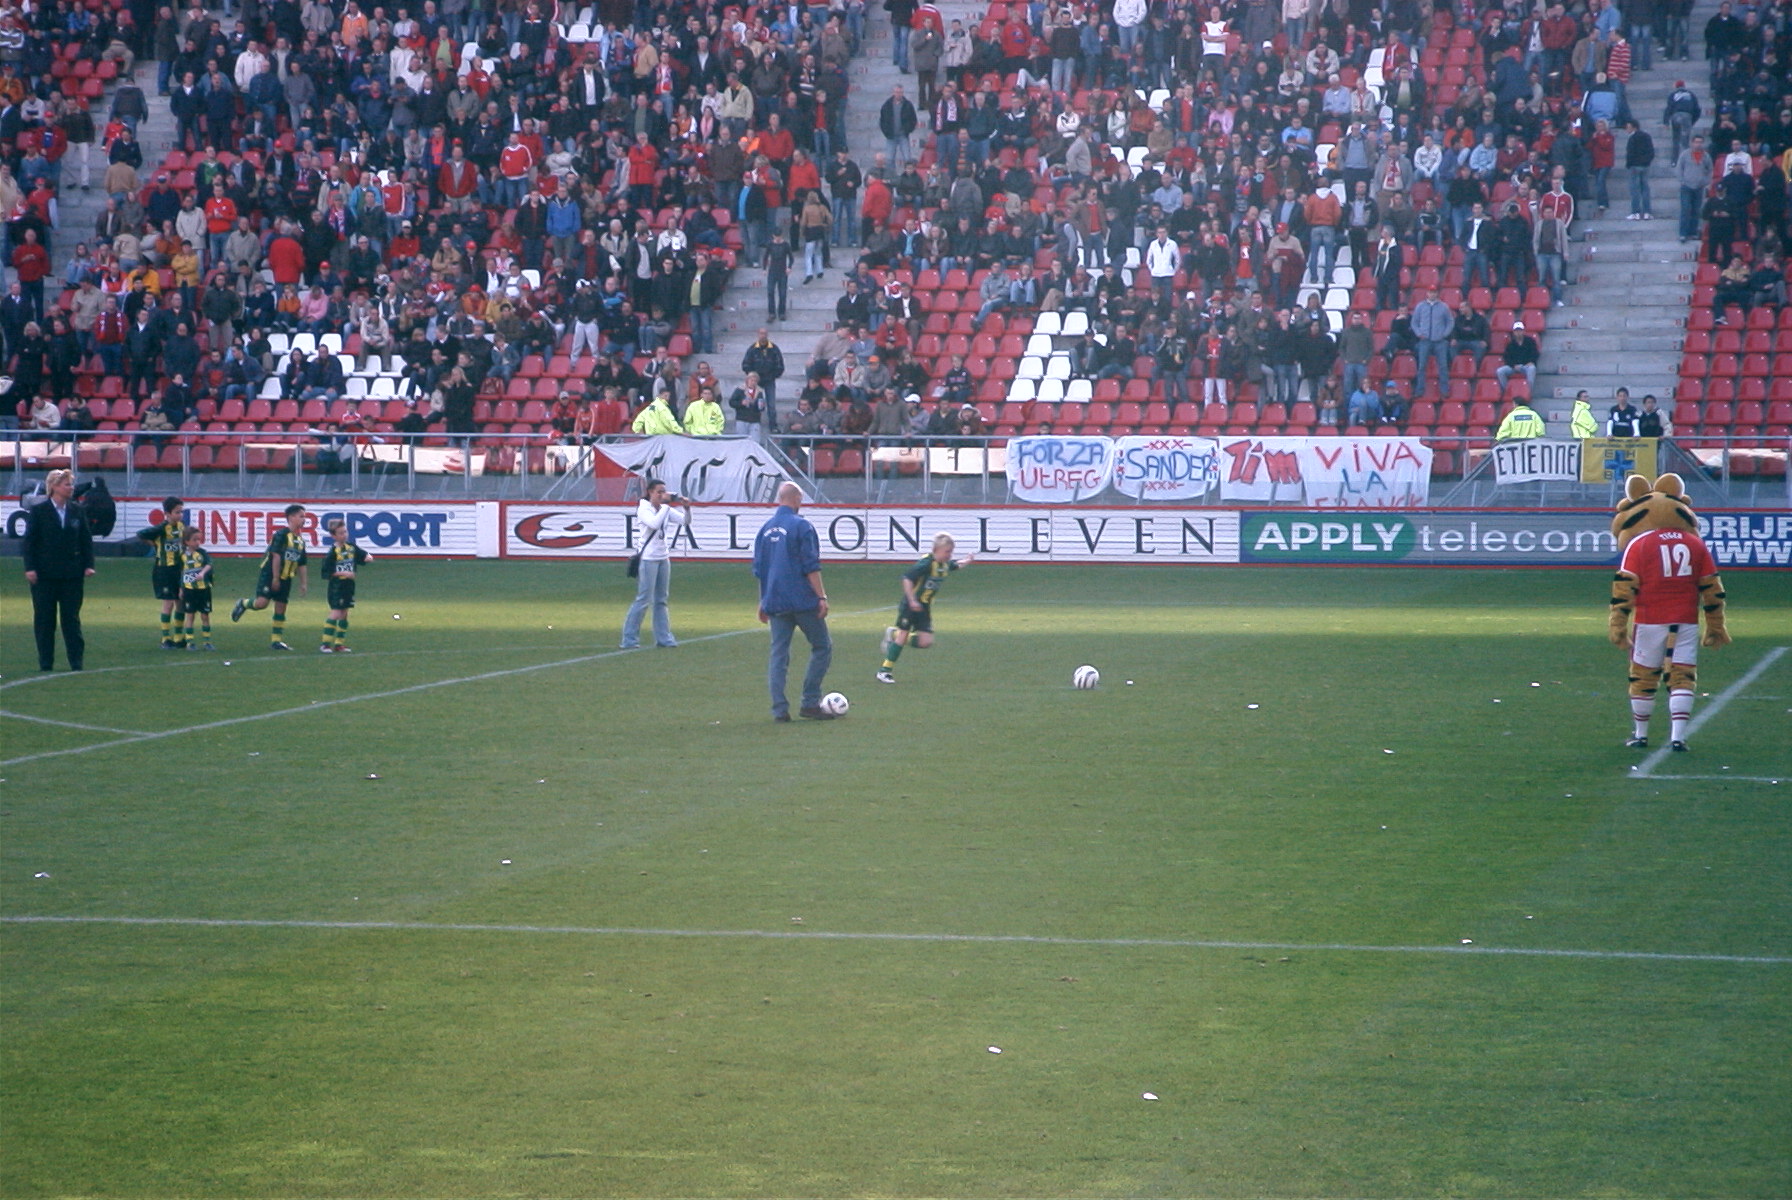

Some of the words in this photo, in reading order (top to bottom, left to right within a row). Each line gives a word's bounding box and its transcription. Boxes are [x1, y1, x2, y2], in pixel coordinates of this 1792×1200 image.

[1016, 441, 1104, 467] FORZA
[1126, 447, 1213, 481] SANDER
[1342, 468, 1388, 493] LA
[200, 509, 448, 548] INTERSPORT
[624, 514, 924, 553] FALON
[976, 516, 1218, 555] LEVEN
[1254, 521, 1404, 551] APPLY
[1419, 521, 1618, 553] telecom
[1659, 543, 1693, 578] 12
